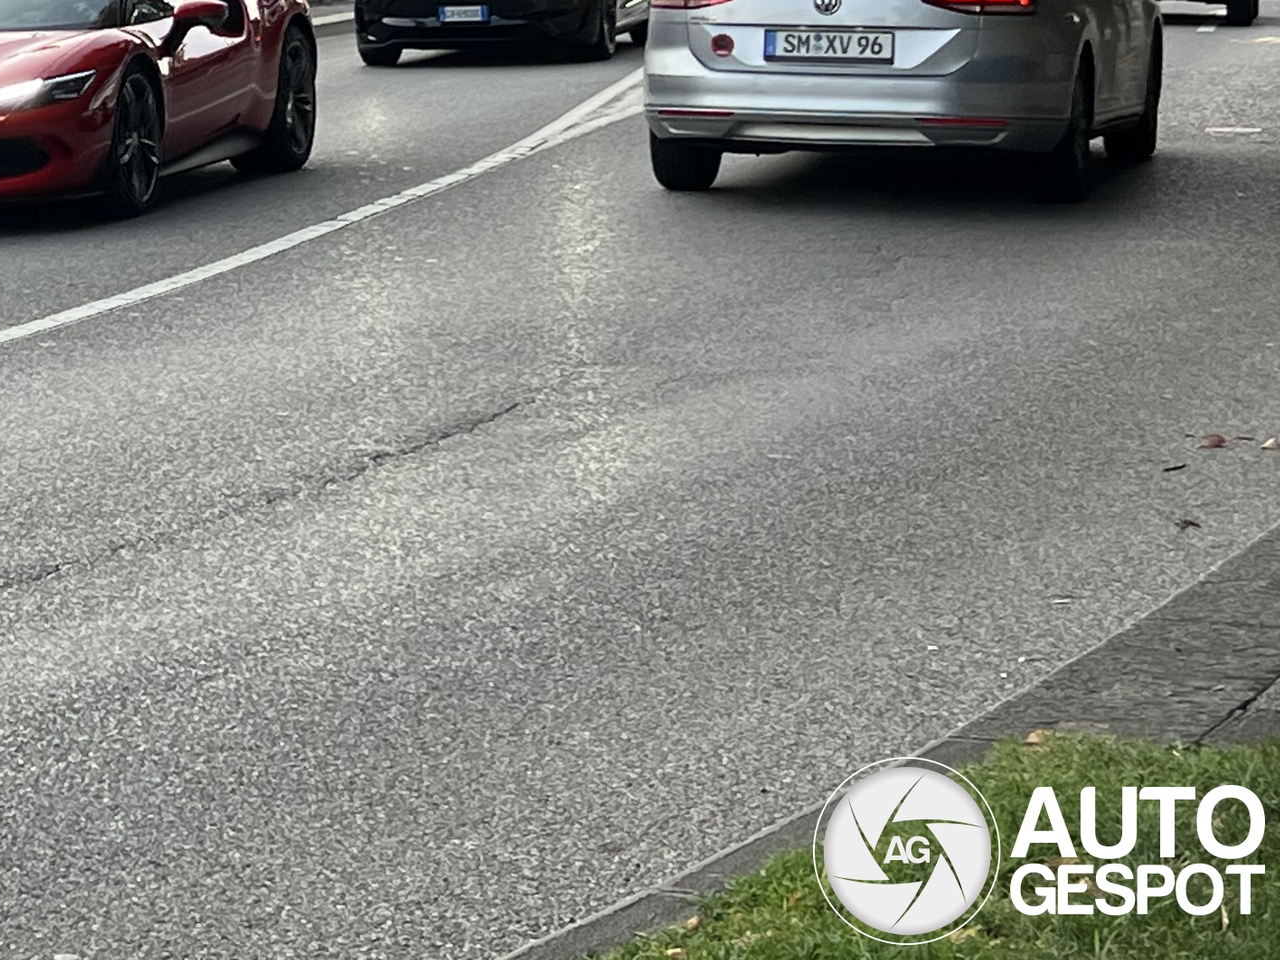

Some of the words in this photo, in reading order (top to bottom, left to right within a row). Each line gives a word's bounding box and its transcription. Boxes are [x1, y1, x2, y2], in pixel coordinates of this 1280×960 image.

[783, 34, 811, 53] SM
[824, 35, 852, 54] XV
[857, 35, 883, 55] 96
